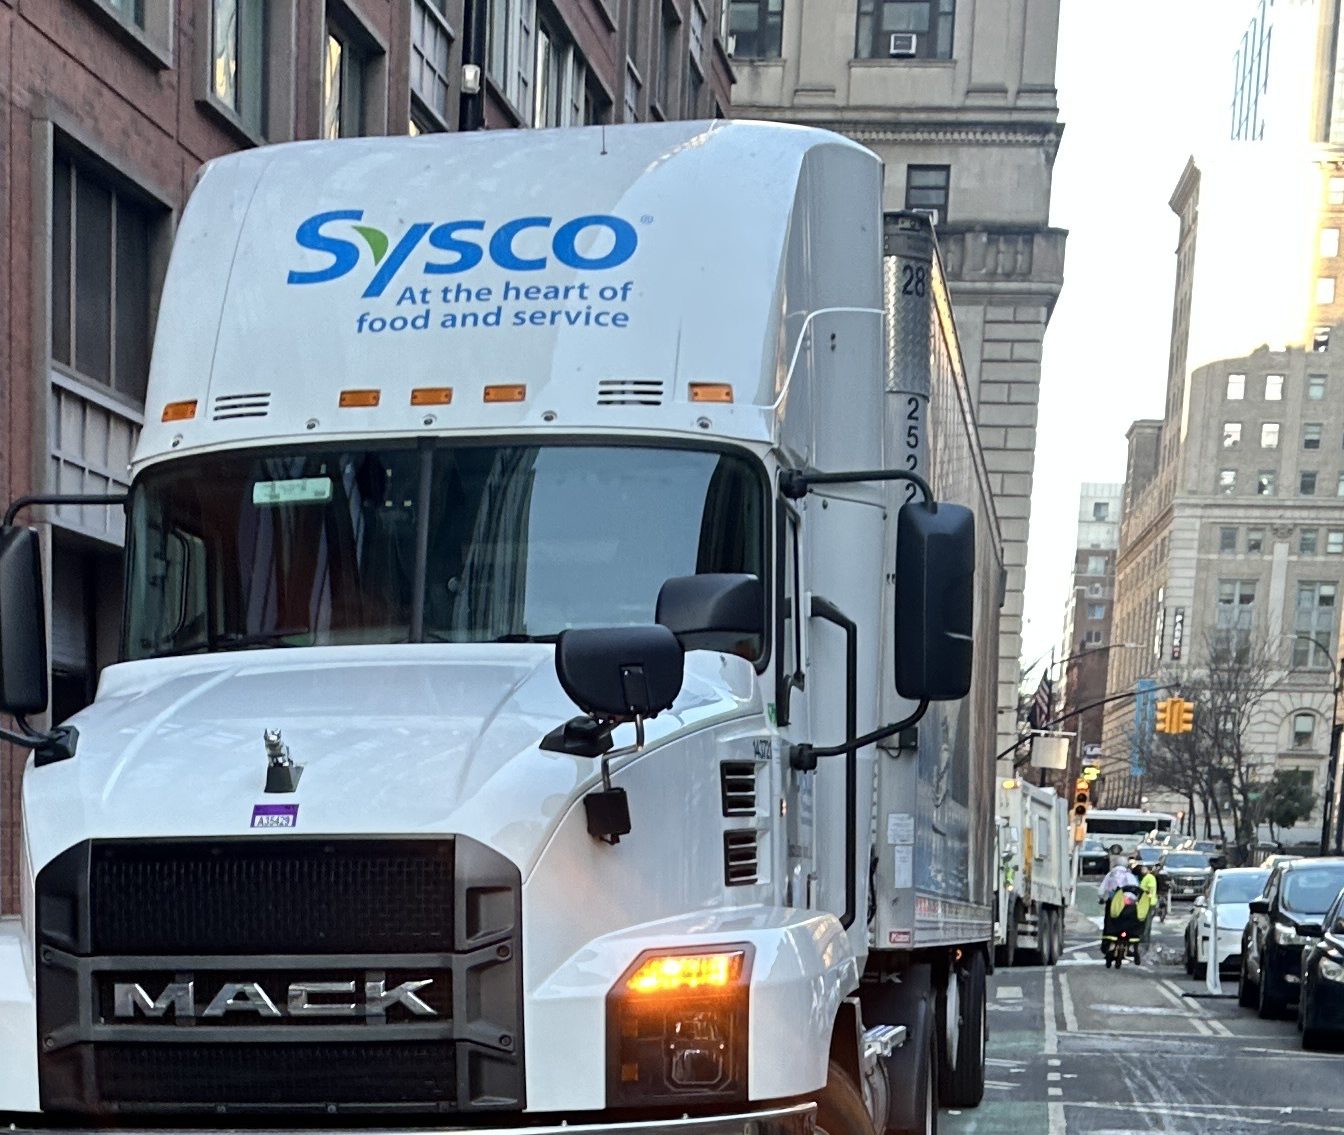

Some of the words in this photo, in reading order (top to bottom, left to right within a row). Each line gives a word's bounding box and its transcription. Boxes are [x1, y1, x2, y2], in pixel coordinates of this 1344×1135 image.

[395, 286, 430, 306] At
[440, 283, 493, 304] the
[502, 281, 590, 302] heart
[598, 281, 634, 302] of
[902, 263, 926, 298] 28
[356, 309, 431, 334] food
[440, 305, 503, 330] and
[512, 304, 631, 329] service
[113, 979, 439, 1018] MACK
